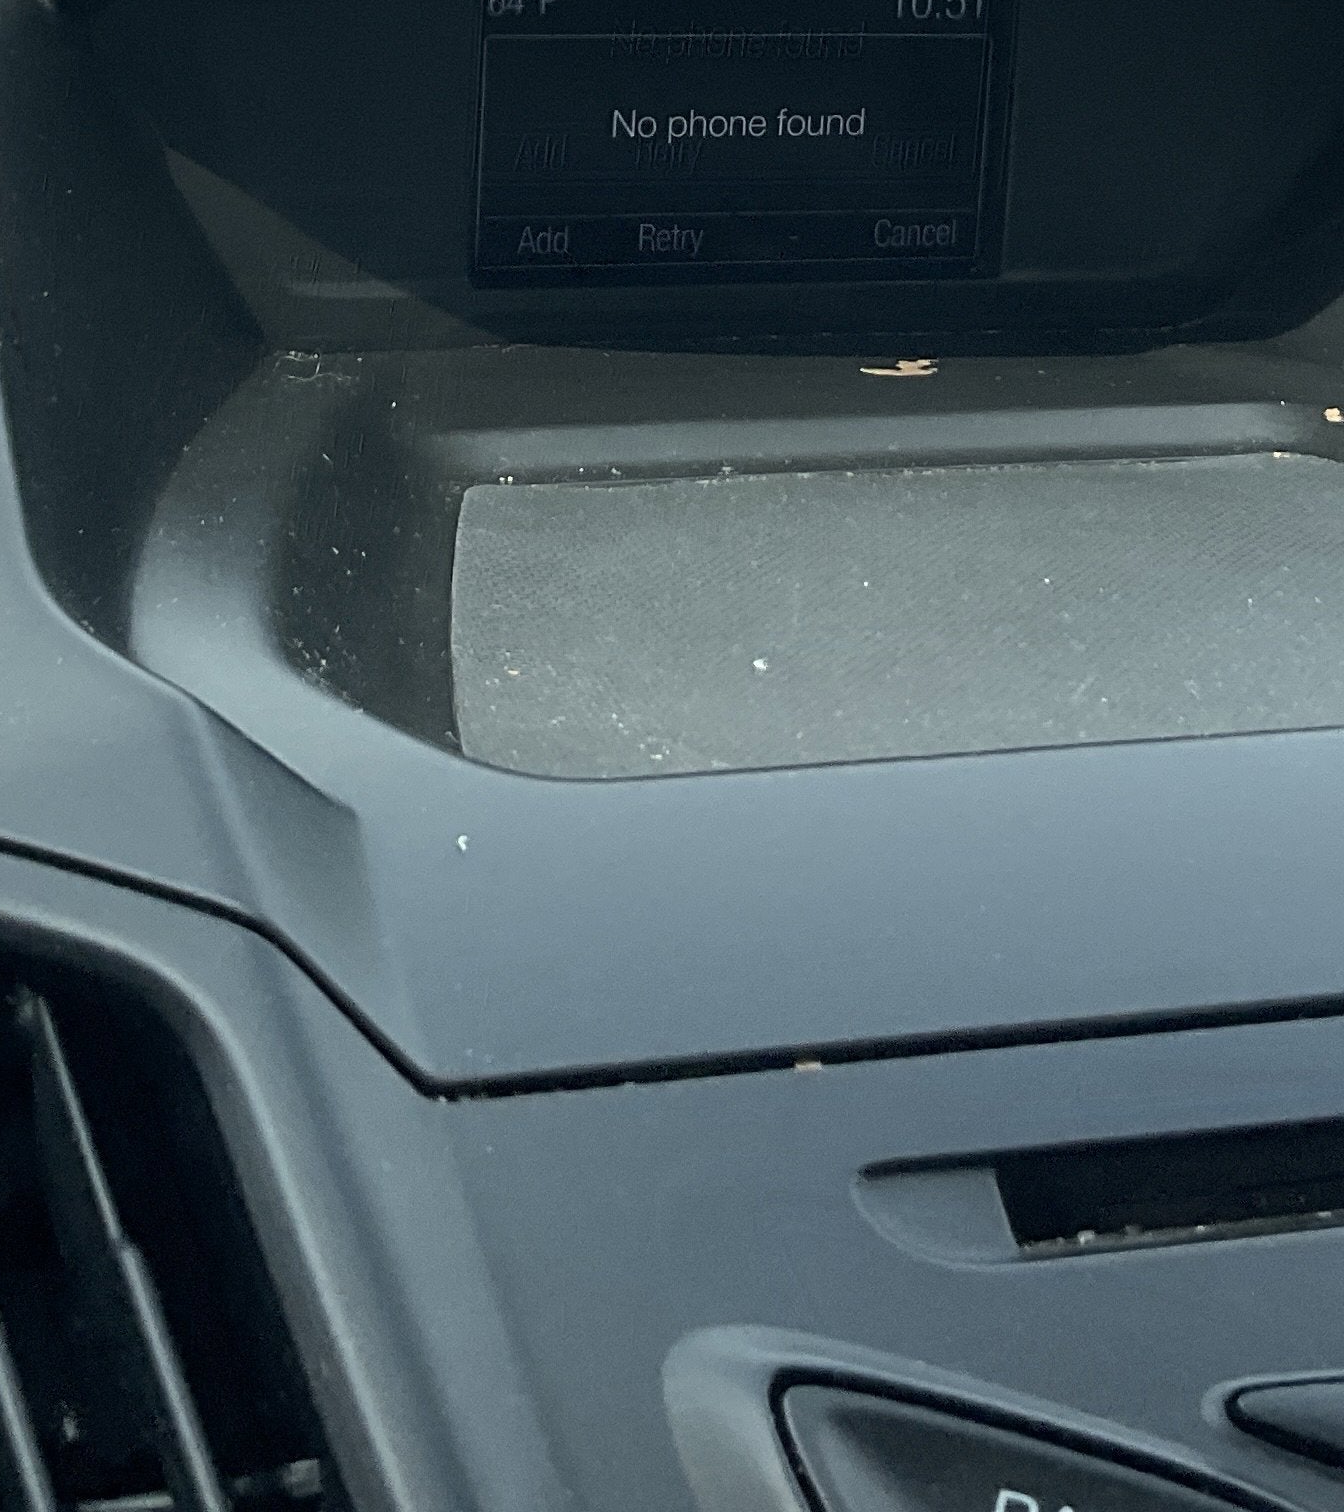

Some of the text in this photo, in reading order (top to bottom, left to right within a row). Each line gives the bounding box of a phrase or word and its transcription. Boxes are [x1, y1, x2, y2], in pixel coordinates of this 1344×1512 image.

[612, 107, 866, 144] No phone found
[517, 225, 569, 254] Add
[637, 223, 704, 256] Retry
[873, 218, 958, 248] Cancel
